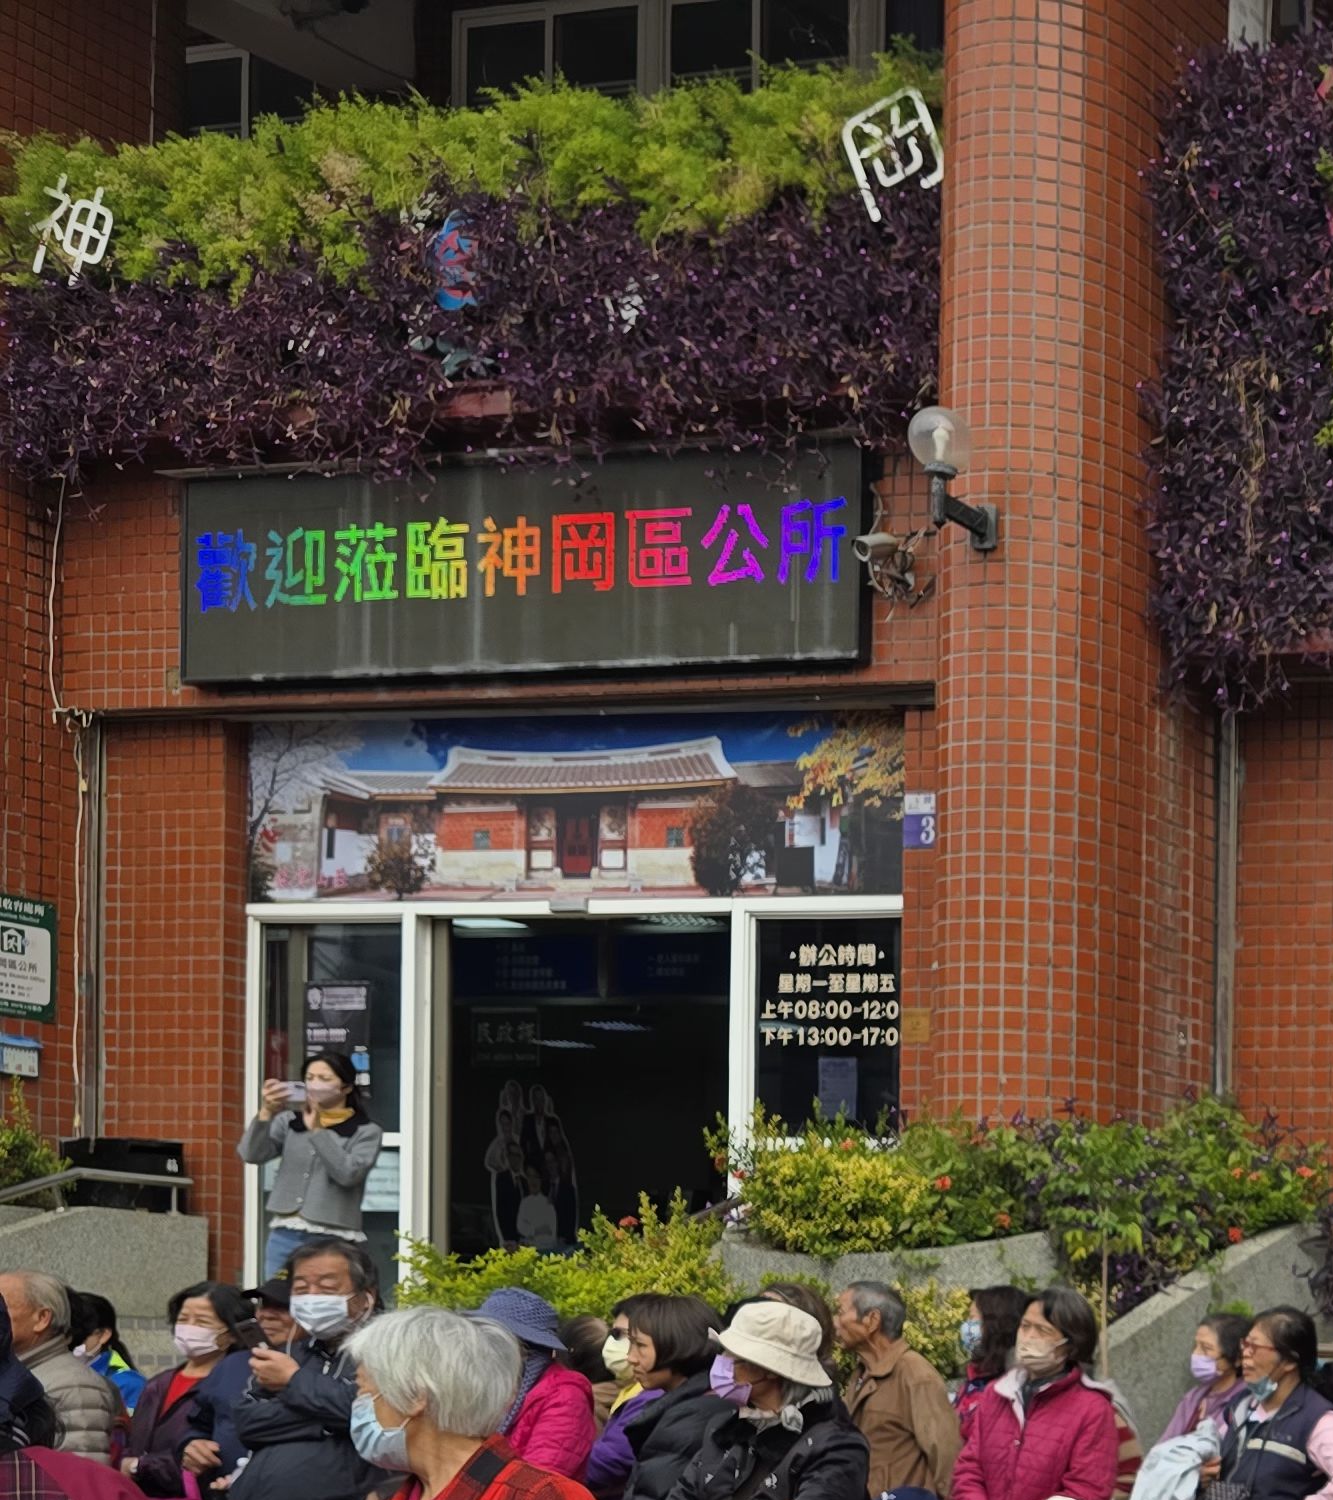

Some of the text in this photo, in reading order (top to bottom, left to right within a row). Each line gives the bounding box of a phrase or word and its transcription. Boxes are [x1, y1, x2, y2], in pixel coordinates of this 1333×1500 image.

[842, 86, 945, 223] 岡
[29, 172, 114, 288] 神
[194, 496, 848, 614] 歡迎蒞臨神岡區公所
[920, 815, 936, 845] 3
[778, 973, 897, 994] 星期一至星期五
[799, 944, 877, 967] 辦公時間
